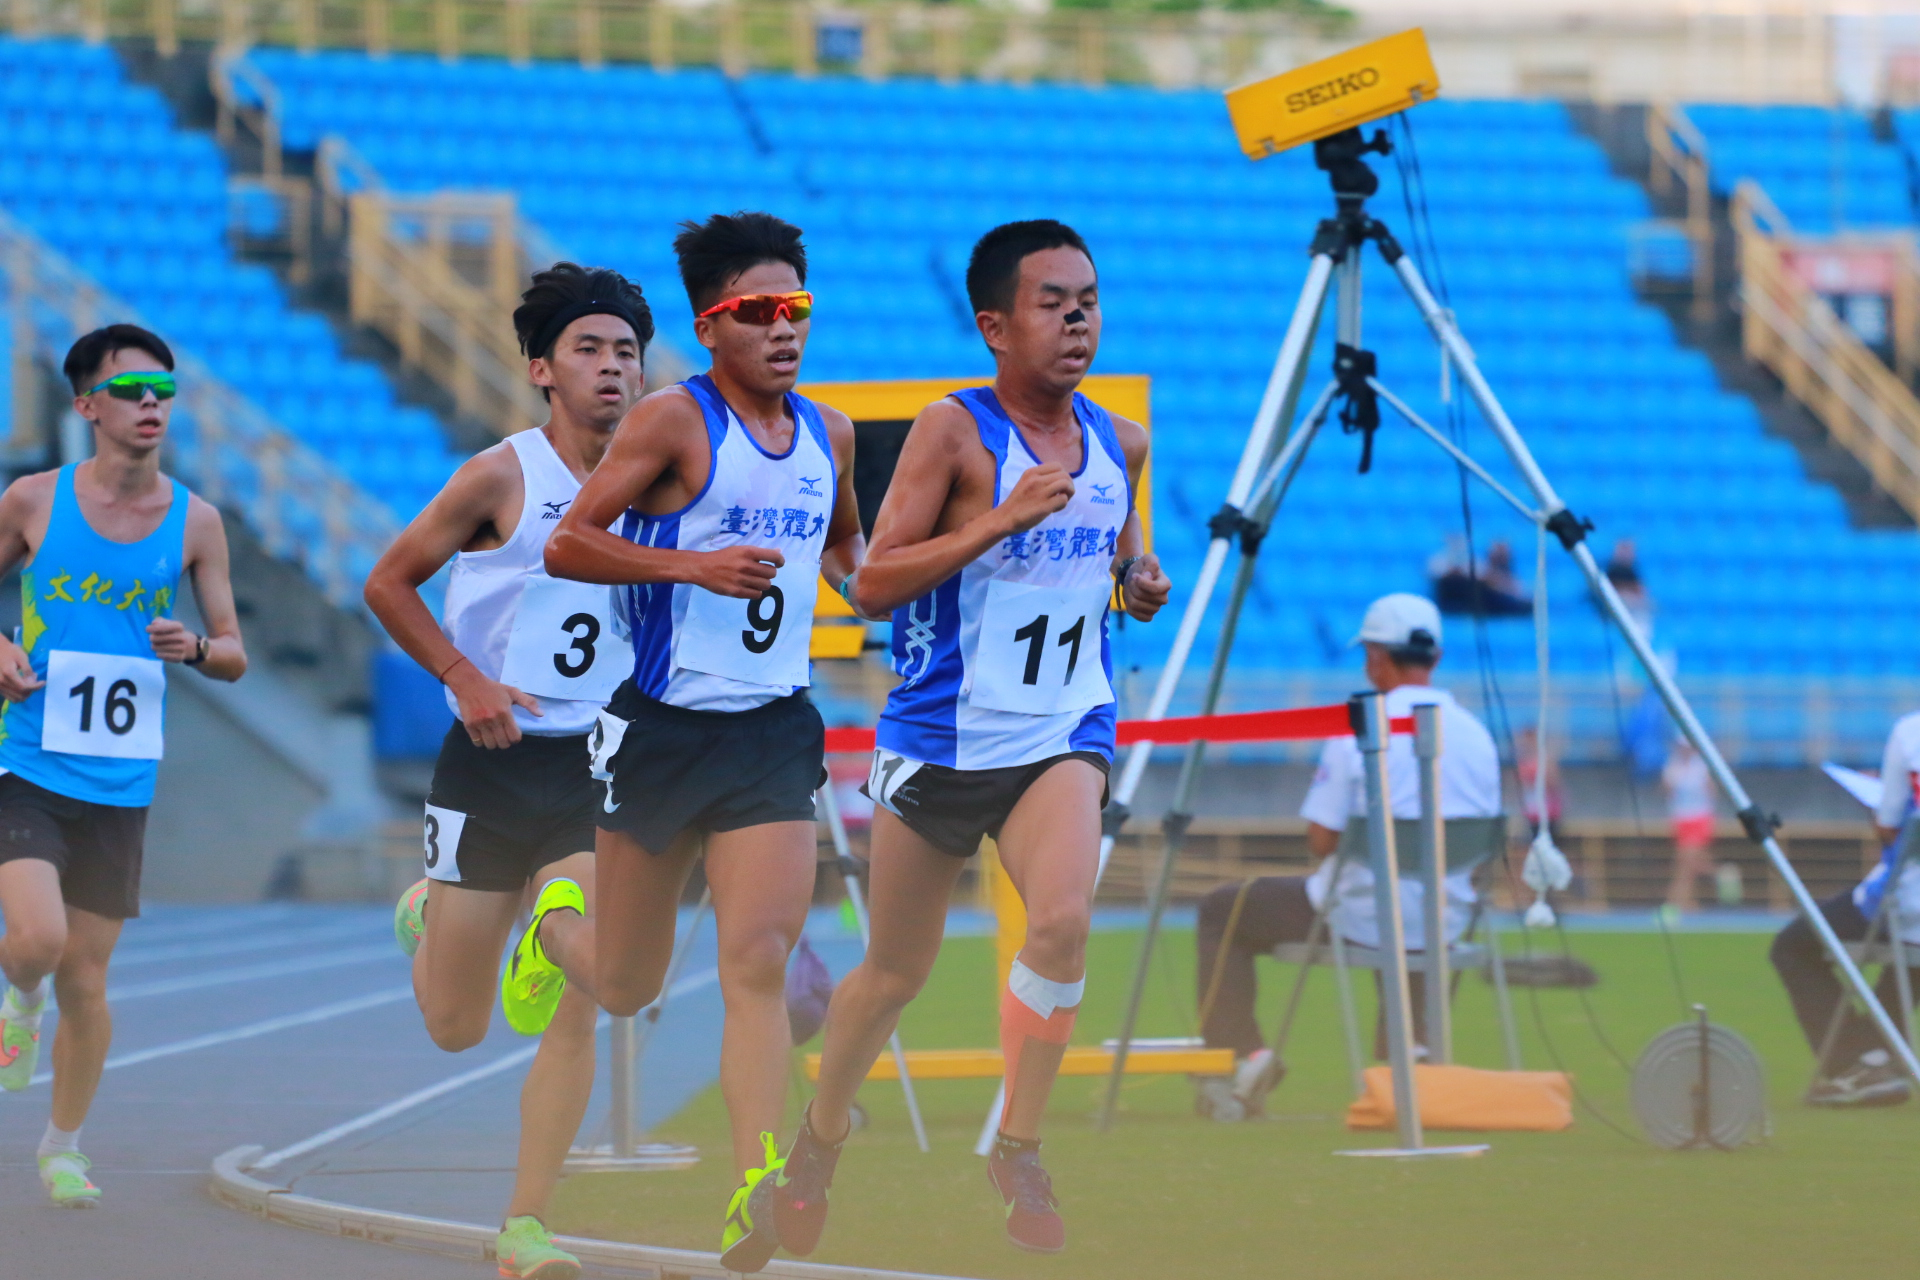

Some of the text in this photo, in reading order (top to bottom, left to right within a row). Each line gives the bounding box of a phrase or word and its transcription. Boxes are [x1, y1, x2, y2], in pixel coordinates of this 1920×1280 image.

[1284, 67, 1380, 114] SEIKO
[553, 612, 601, 679] 3
[742, 585, 785, 654] 9
[1013, 614, 1086, 687] 11
[69, 676, 138, 736] 16
[425, 813, 440, 869] 3
